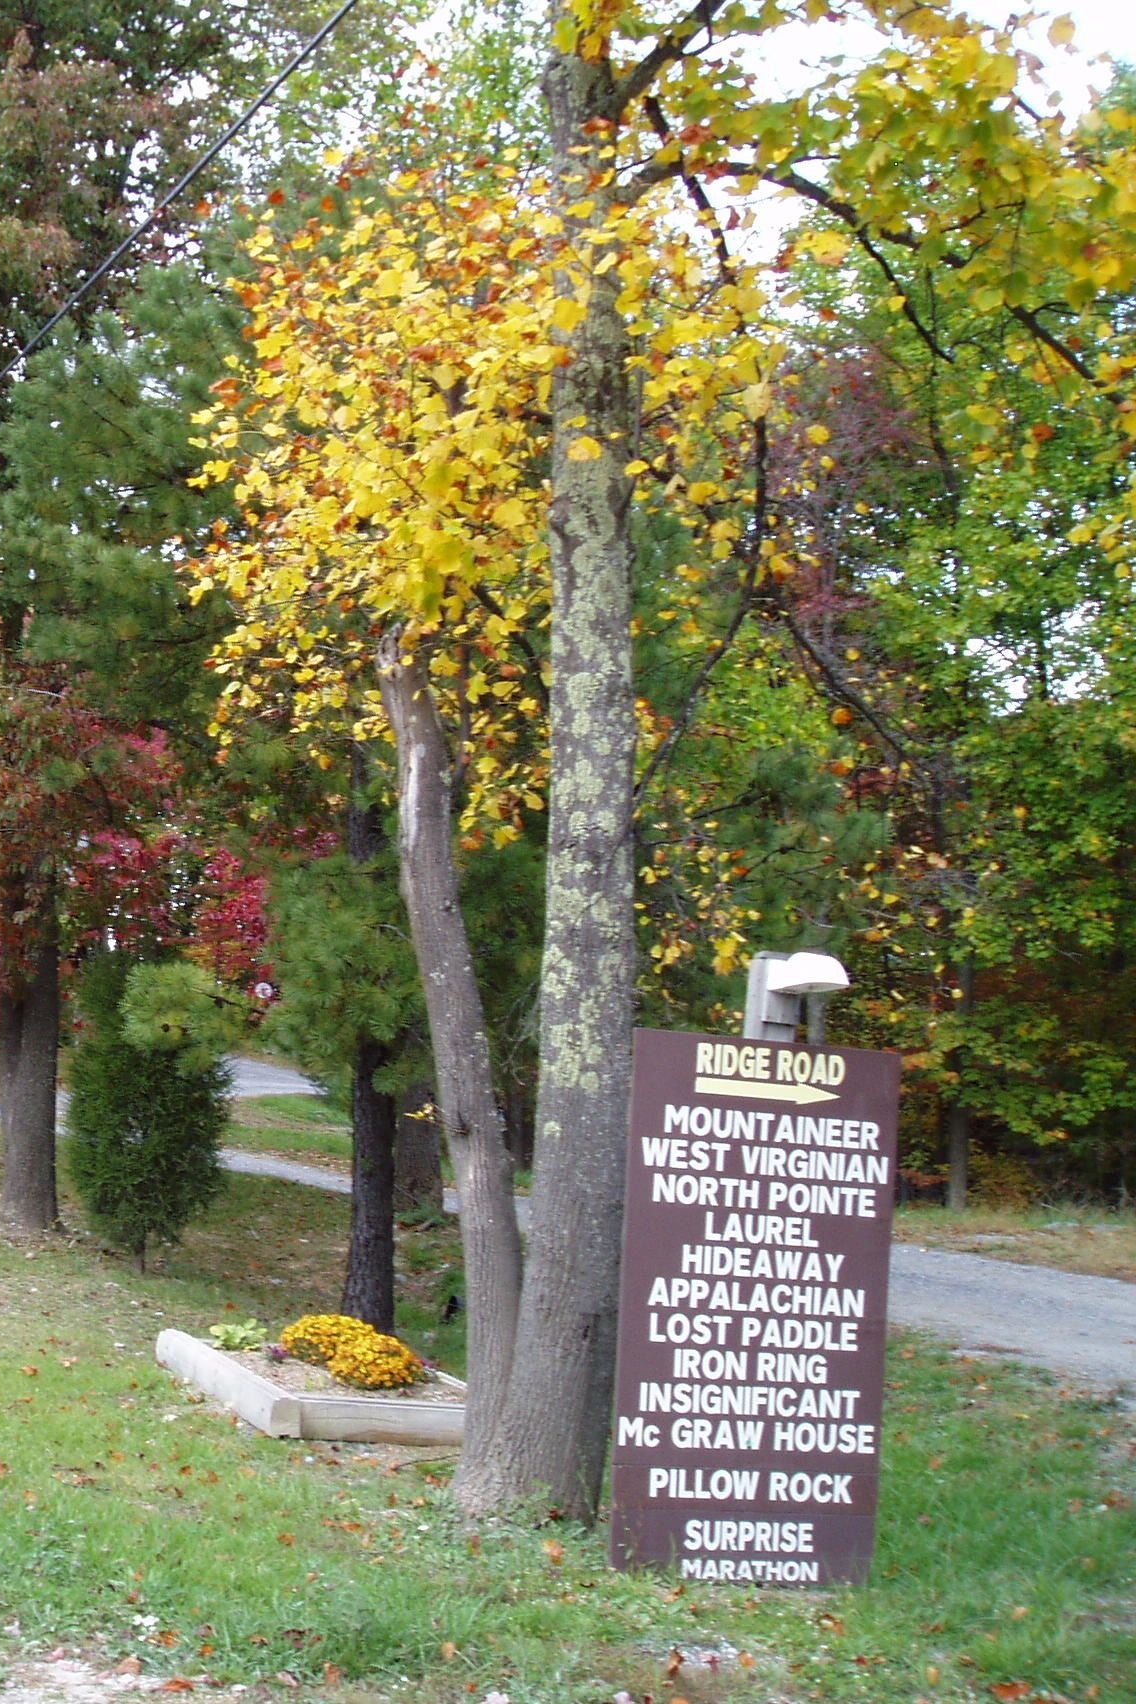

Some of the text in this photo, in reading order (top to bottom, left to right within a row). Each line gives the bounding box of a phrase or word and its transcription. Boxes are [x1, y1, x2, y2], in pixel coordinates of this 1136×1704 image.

[696, 1042, 846, 1086] RIDGE ROAD
[664, 1104, 880, 1150] MOUNTAINEER
[642, 1136, 889, 1184] WEST VIRGINIAN
[652, 1174, 876, 1218] NORTH POINTE
[704, 1212, 820, 1248] LAUREL
[682, 1244, 846, 1282] HIDEAWAY
[648, 1278, 864, 1318] APPALACHIAN
[649, 1313, 858, 1351] LOST PADDLE
[673, 1348, 827, 1384] IRON RING
[639, 1382, 860, 1419] INSIGNIFICANT
[618, 1417, 875, 1454] Mc GRAW HOUSE
[649, 1468, 853, 1504] PILLOW ROCK
[684, 1520, 814, 1553] SURPRISE
[681, 1559, 819, 1582] MARATHON
